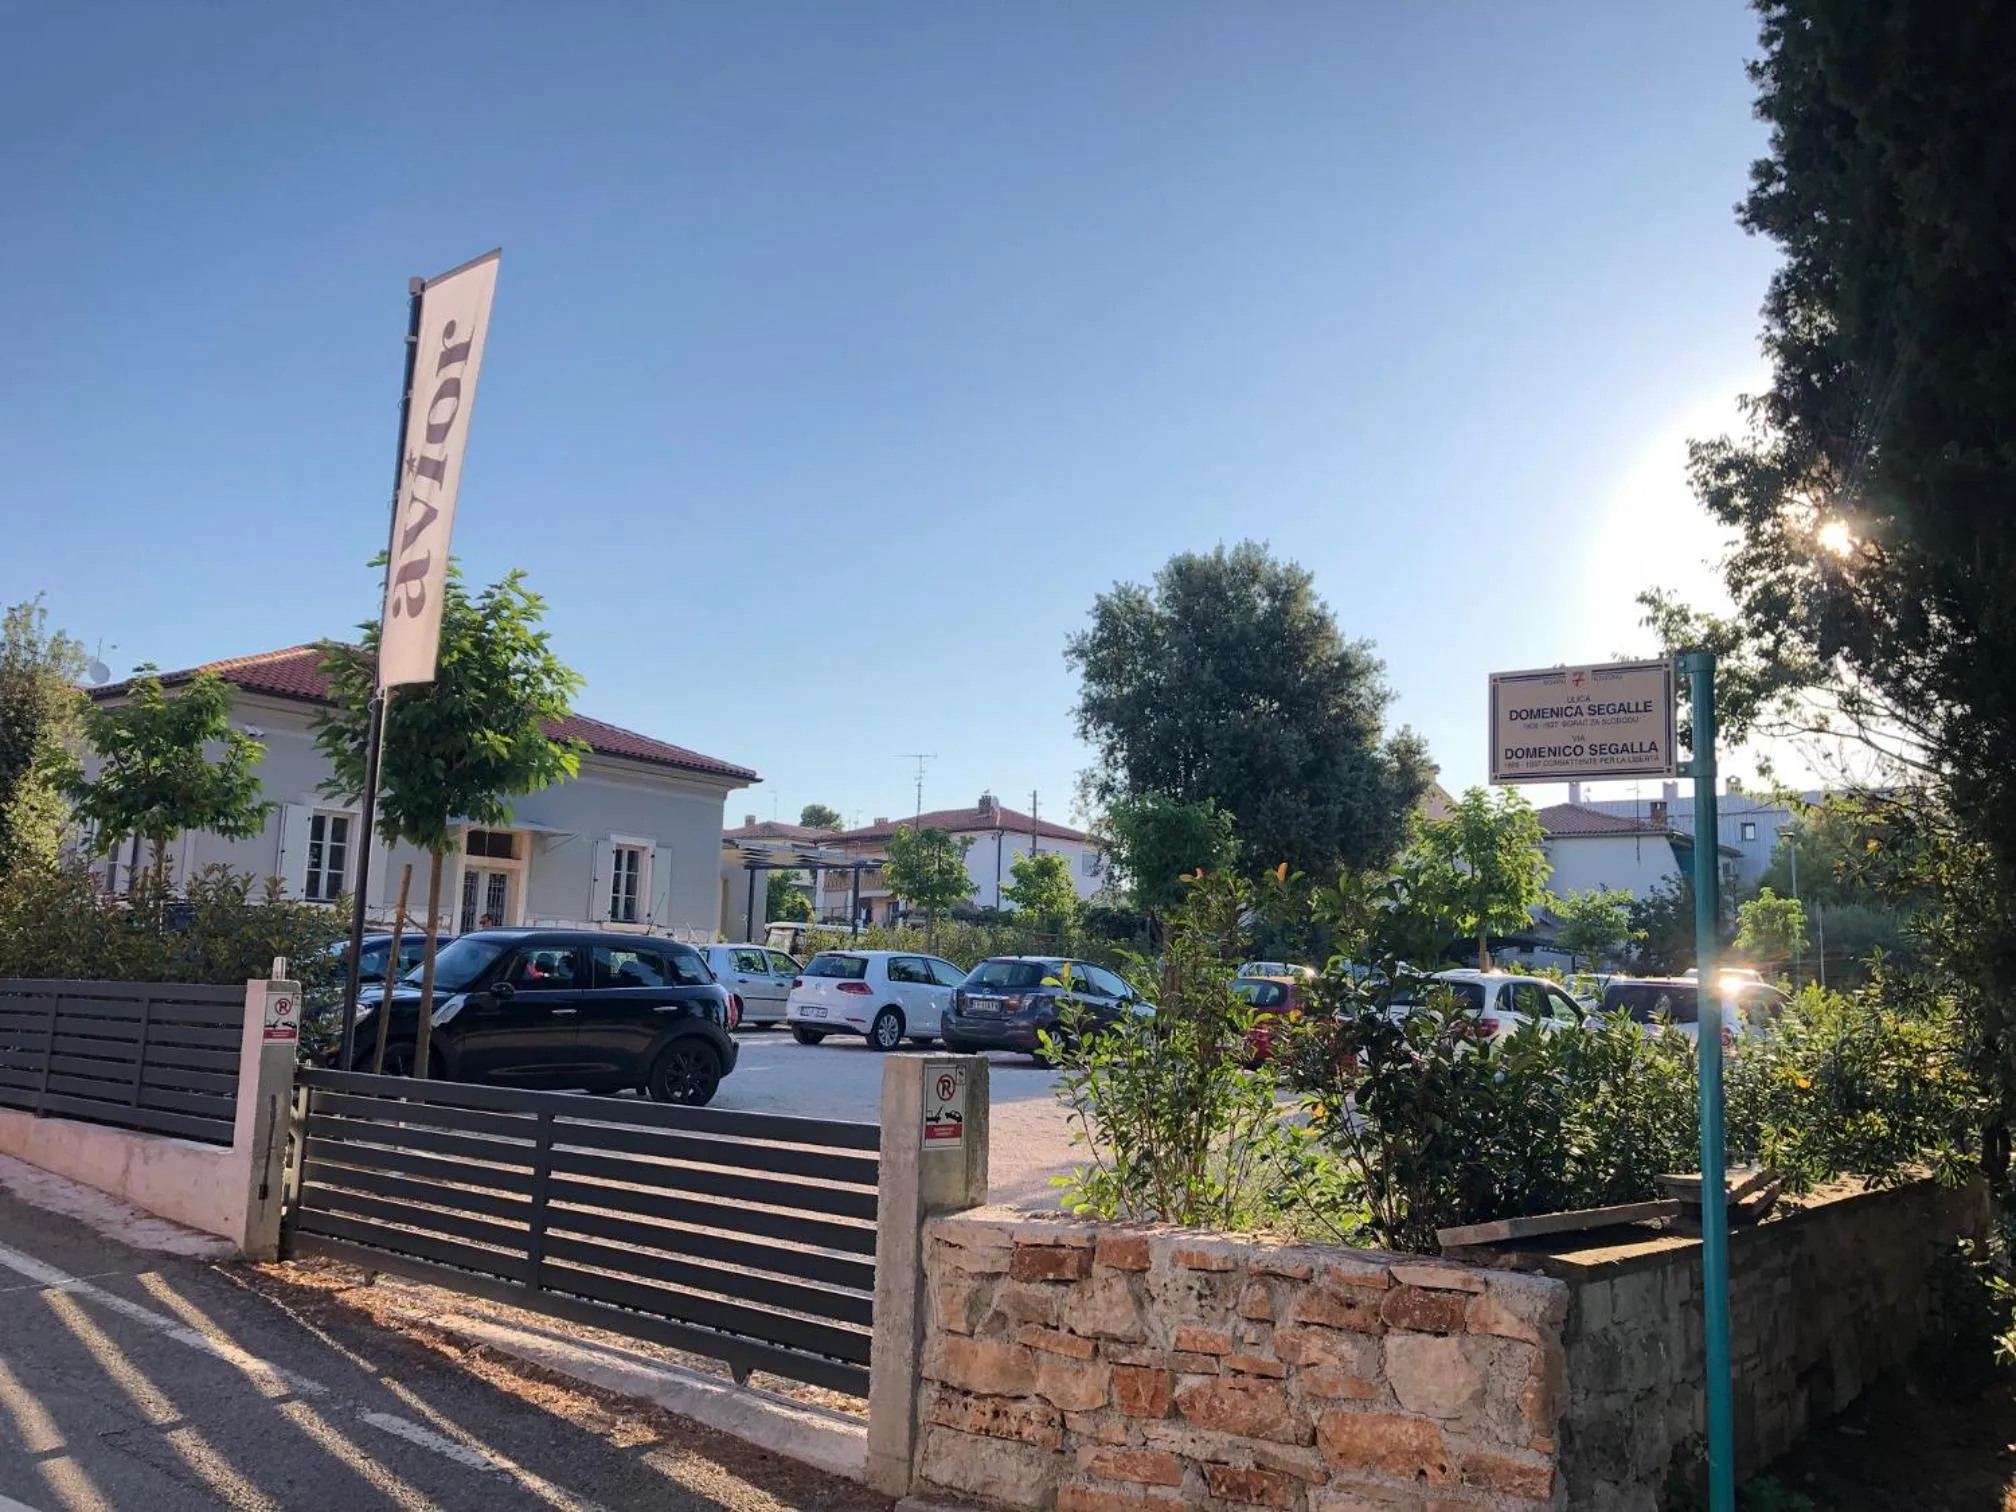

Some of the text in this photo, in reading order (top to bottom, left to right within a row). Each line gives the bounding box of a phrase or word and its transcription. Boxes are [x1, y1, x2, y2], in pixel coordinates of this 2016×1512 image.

[393, 319, 476, 620] avior
[1566, 694, 1591, 703] ULICA
[1508, 700, 1653, 721] DOMENICA SEGALLE
[1571, 734, 1586, 742] VIA
[1504, 741, 1658, 760] DOMENICO SEGALLA
